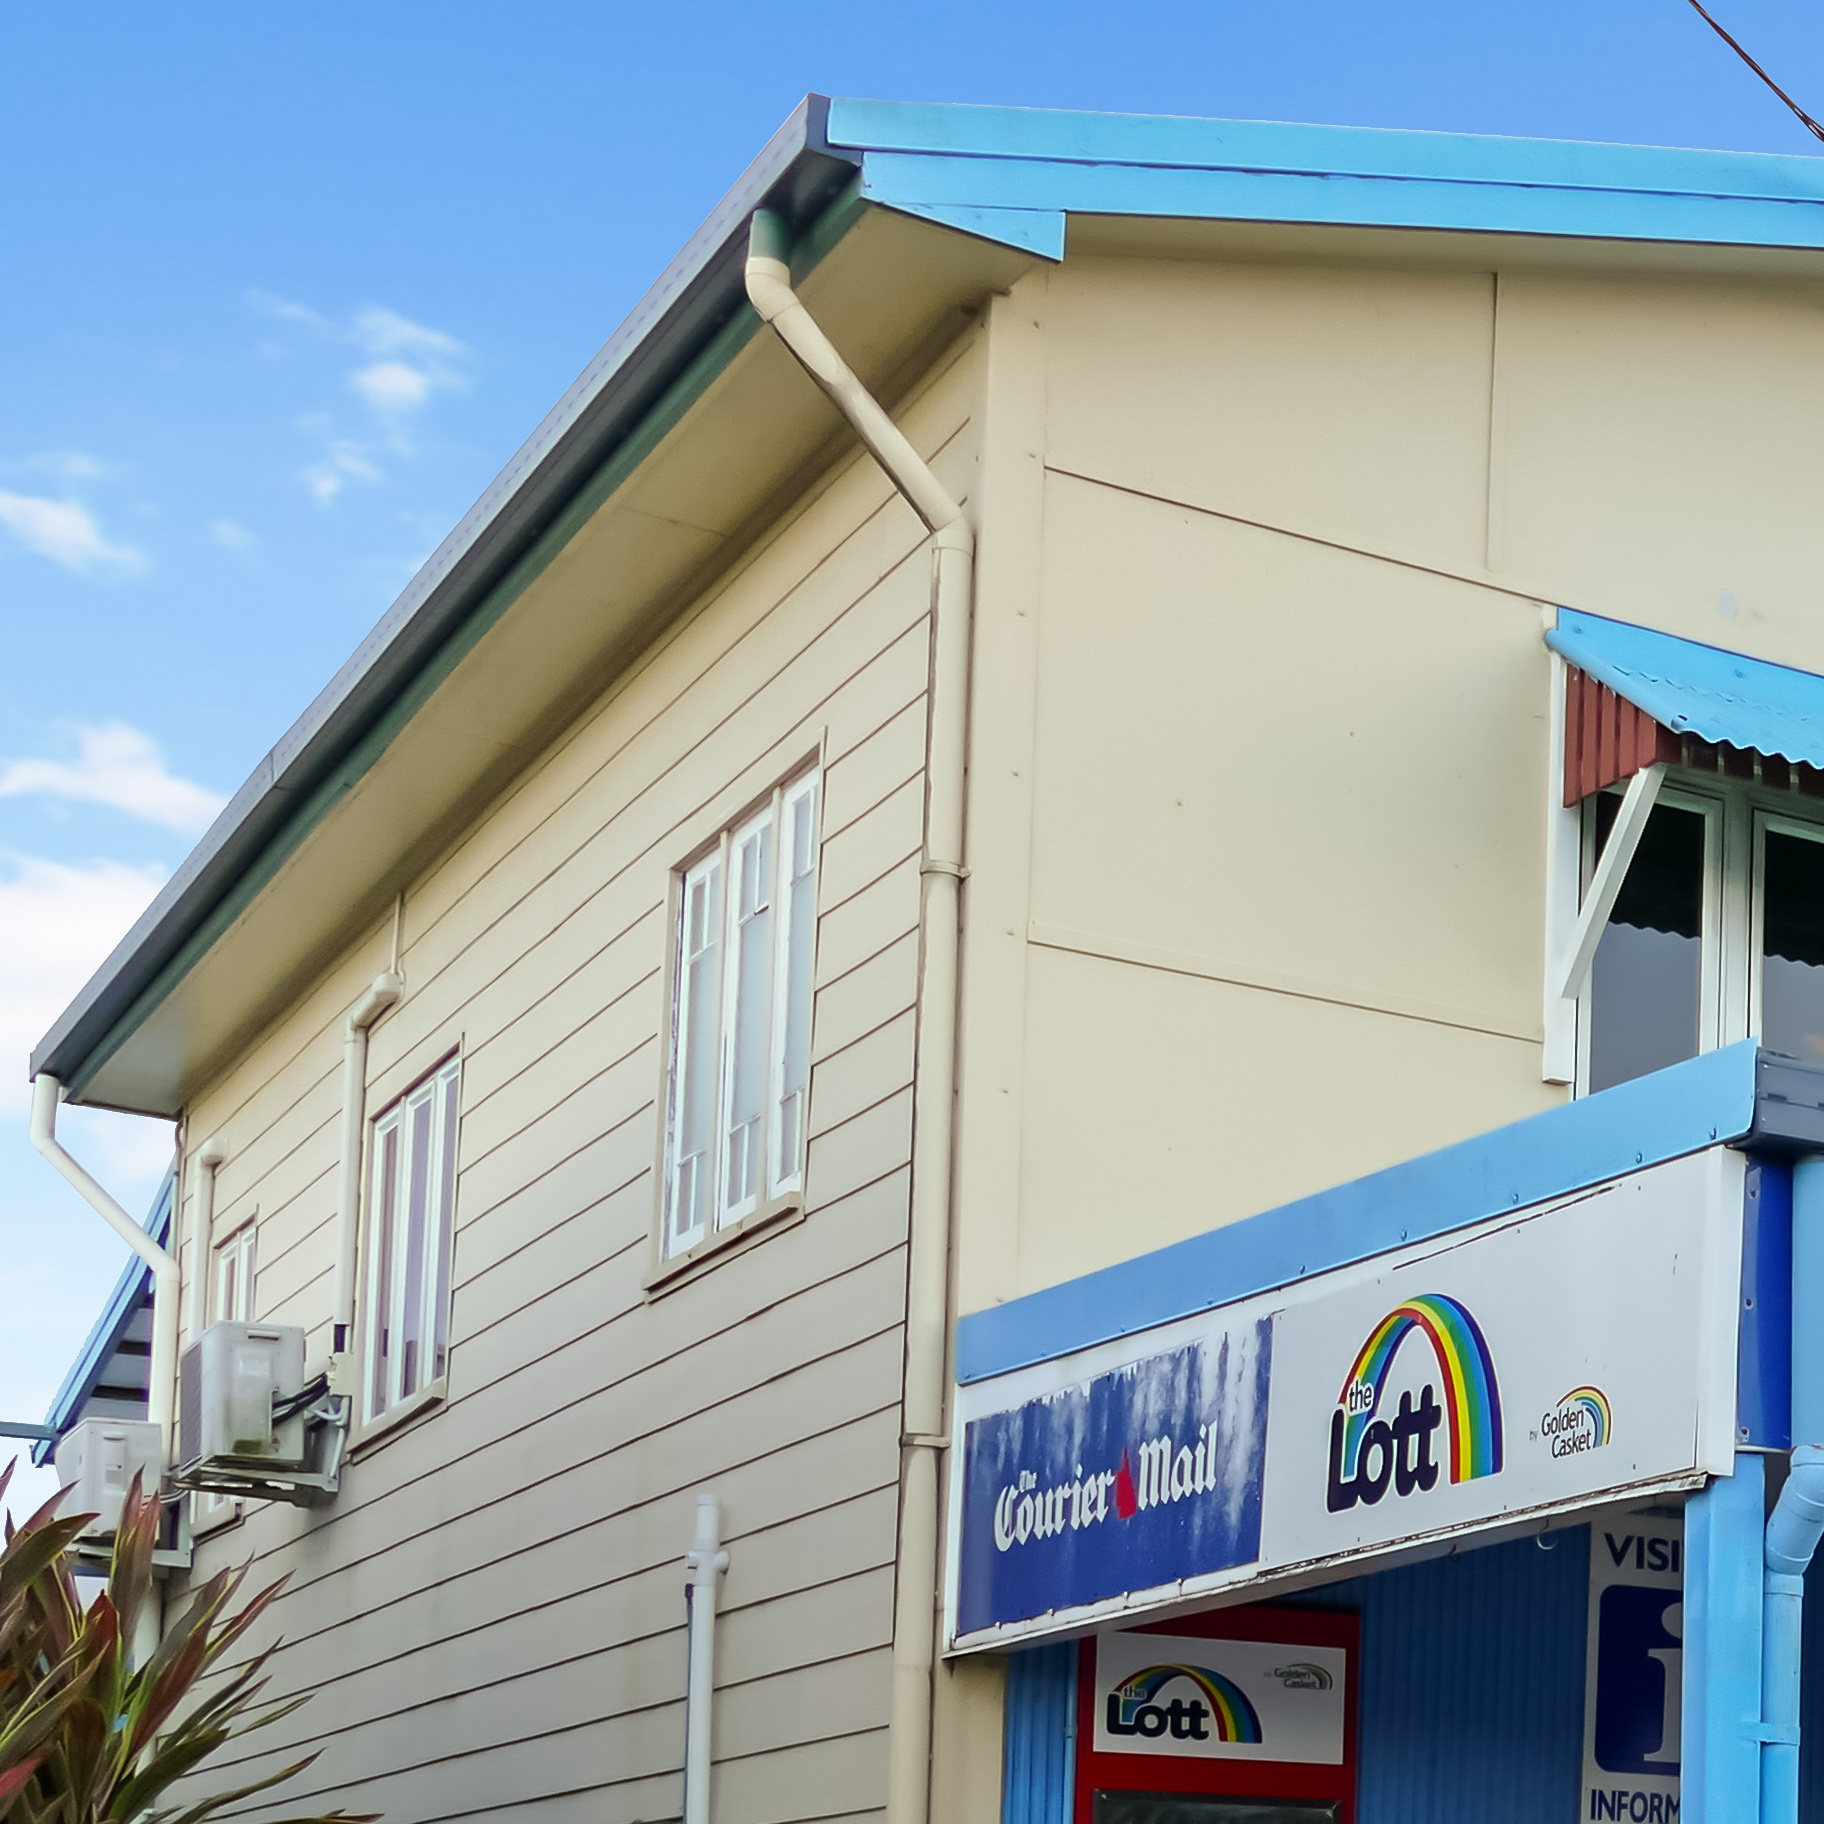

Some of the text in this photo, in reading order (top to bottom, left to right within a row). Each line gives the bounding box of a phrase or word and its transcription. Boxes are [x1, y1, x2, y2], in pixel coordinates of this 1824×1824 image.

[1348, 1380, 1374, 1415] the
[1540, 1406, 1585, 1436] Golden
[1326, 1383, 1444, 1514] Lott
[1551, 1429, 1593, 1460] Casket
[994, 1420, 1220, 1552] Courier Mail
[1018, 1468, 1037, 1493] The
[1106, 1692, 1210, 1741] Lott
